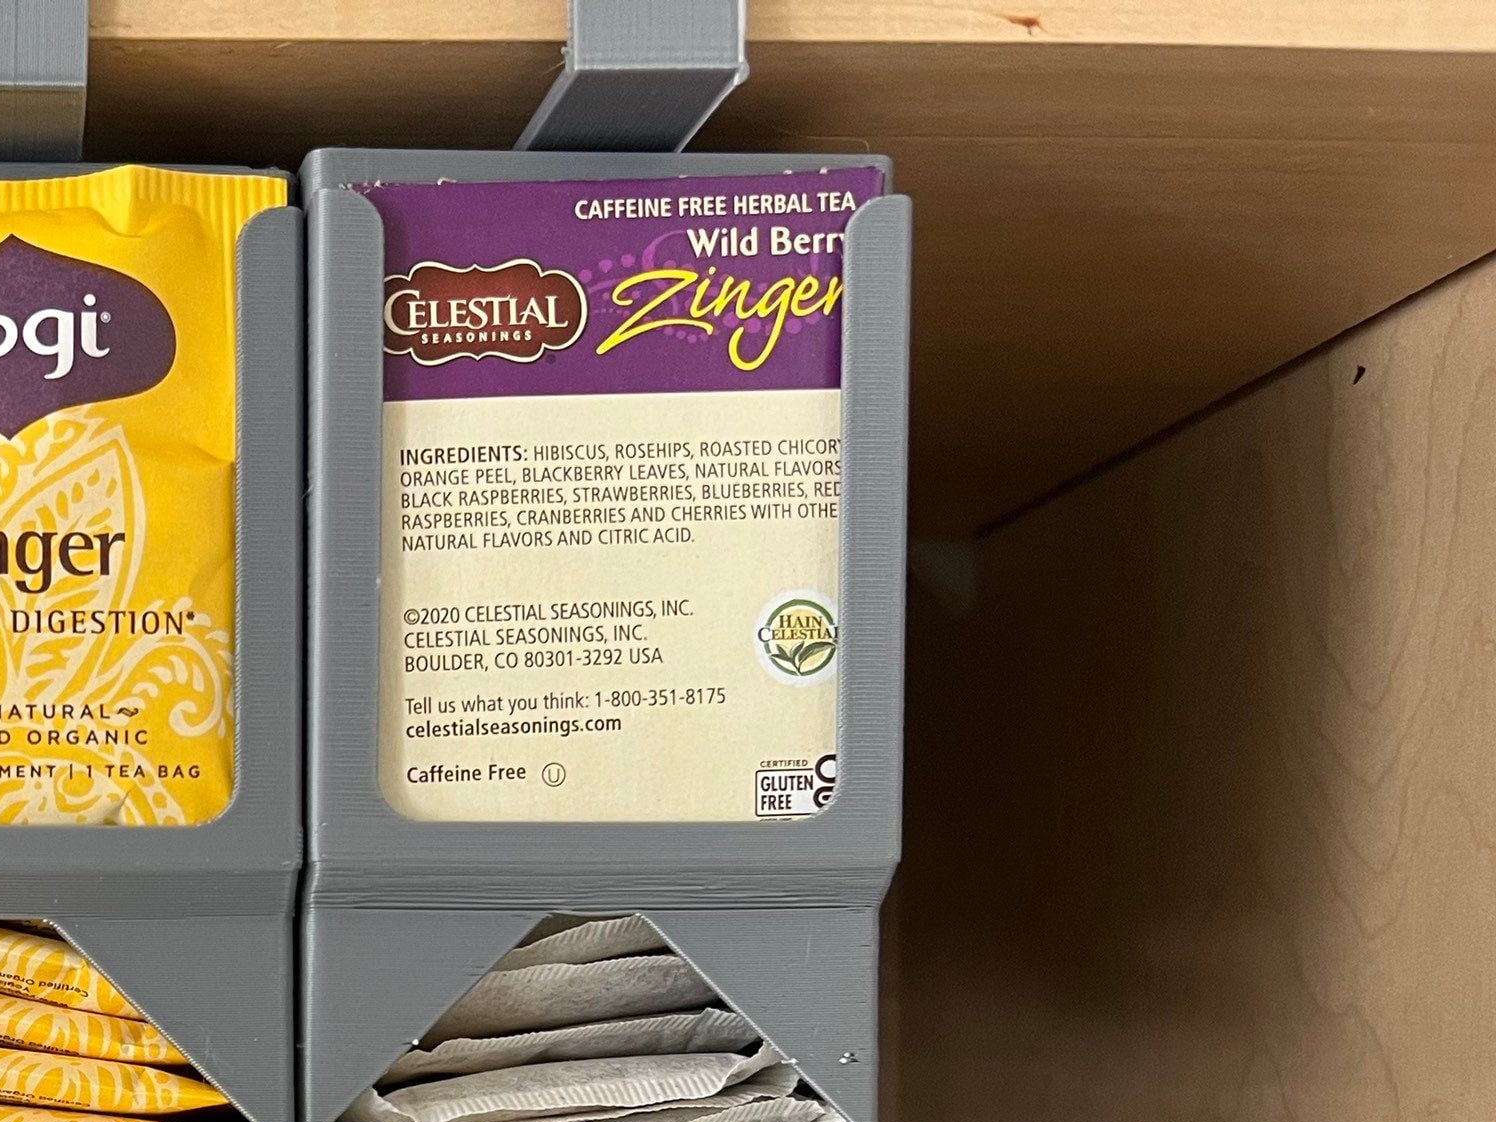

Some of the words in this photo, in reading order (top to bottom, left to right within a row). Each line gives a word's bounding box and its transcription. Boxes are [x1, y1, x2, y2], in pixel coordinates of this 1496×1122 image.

[574, 197, 672, 220] CAFFEINE
[678, 196, 727, 217] FREE
[733, 193, 812, 216] HERBAL
[817, 191, 856, 213] TEA
[687, 227, 758, 259] Wild
[770, 226, 845, 256] Berr
[421, 330, 532, 344] SEASONINGS
[400, 445, 528, 466] INGREDIENTS:
[533, 443, 610, 463] HIBISCUS,
[614, 441, 695, 461] ROSEHIPS,
[700, 440, 772, 458] ROASTED
[400, 468, 470, 487] ORANGE
[475, 467, 516, 486] PEEL,
[522, 465, 623, 483] BLACKBERRY
[629, 463, 690, 482] LEAVES,
[695, 462, 768, 479] NATURAL
[400, 491, 453, 510] BLACK
[459, 488, 568, 508] RASPBERRIES,
[573, 485, 696, 505] STRAWBERRIES,
[701, 483, 808, 502] BLUEBERRIES,
[401, 511, 512, 531] RASPBERRIES,
[516, 507, 626, 526] CRANBERRIES
[630, 506, 666, 523] AND
[671, 505, 747, 522] CHERRIES
[751, 503, 792, 520] WITH
[798, 503, 838, 519] OTHE
[402, 532, 477, 552] NATURAL
[483, 530, 553, 549] FLAVORS
[557, 529, 593, 547] AND
[597, 528, 650, 546] CITRIC
[653, 527, 695, 545] ACID.
[404, 607, 460, 626] ©2020
[465, 604, 546, 623] CELESTIAL
[550, 601, 657, 621] SEASONINGS,
[661, 600, 694, 617] INC.
[779, 615, 822, 628] HAIN
[404, 630, 491, 649] CELESTIAL
[496, 626, 607, 646] SEASONINGS,
[613, 624, 647, 643] INC.
[405, 654, 489, 674] BOULDER,
[494, 652, 519, 670] CO
[524, 649, 623, 668] 80301-3292
[629, 648, 663, 665] USA
[406, 698, 432, 715] Tell
[438, 700, 456, 715] us
[461, 696, 503, 713] what
[508, 696, 537, 716] you
[543, 693, 590, 711] think:
[595, 688, 726, 708] 1-800-351-8175
[27, 729, 149, 746] ORGANIC
[406, 716, 622, 738] celestialseasonings.com
[105, 765, 146, 779] TEA
[158, 765, 201, 780] BAG
[407, 765, 482, 784] Caffeine
[488, 764, 526, 781] Free
[761, 775, 813, 791] GLUTEN
[761, 794, 792, 810] FREE
